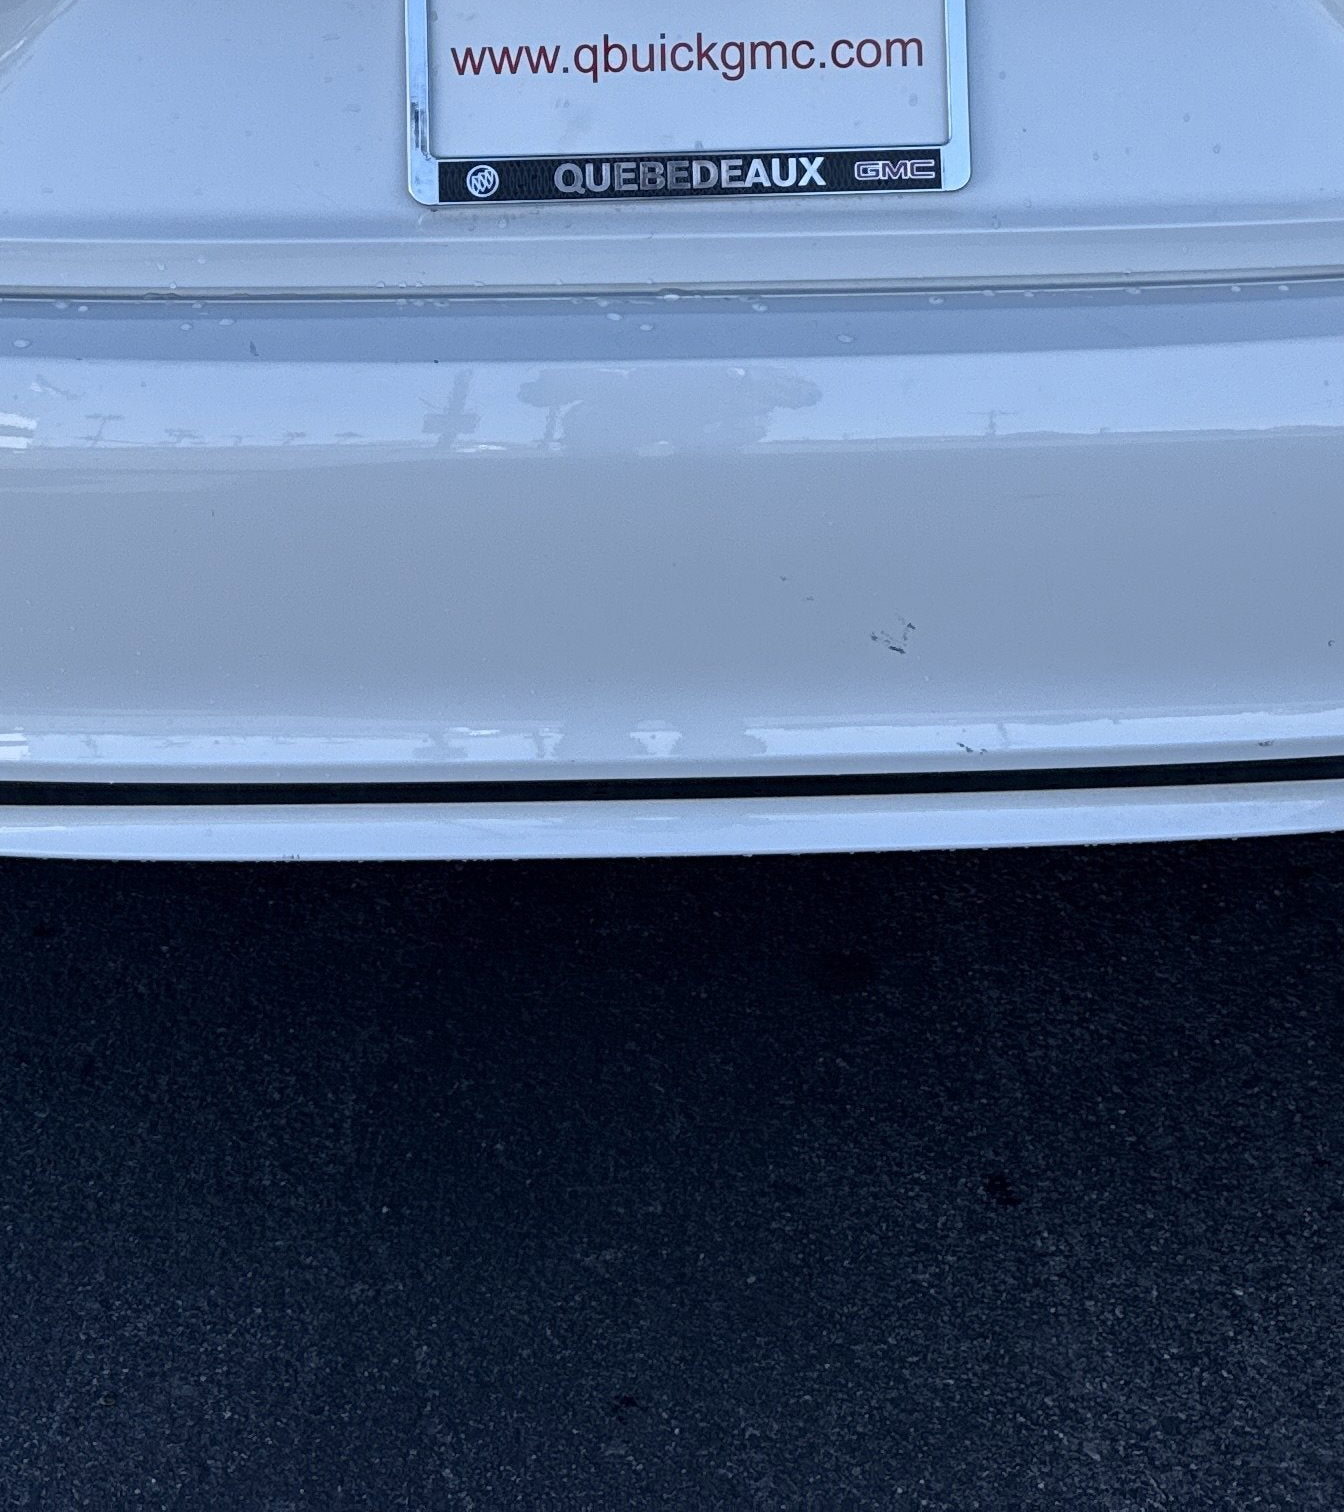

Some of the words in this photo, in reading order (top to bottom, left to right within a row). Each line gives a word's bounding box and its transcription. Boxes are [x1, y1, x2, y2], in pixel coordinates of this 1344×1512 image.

[449, 32, 924, 83] www.qbuickgmc.com
[553, 156, 827, 194] QUEBEDEAUX
[854, 159, 936, 180] GMC
